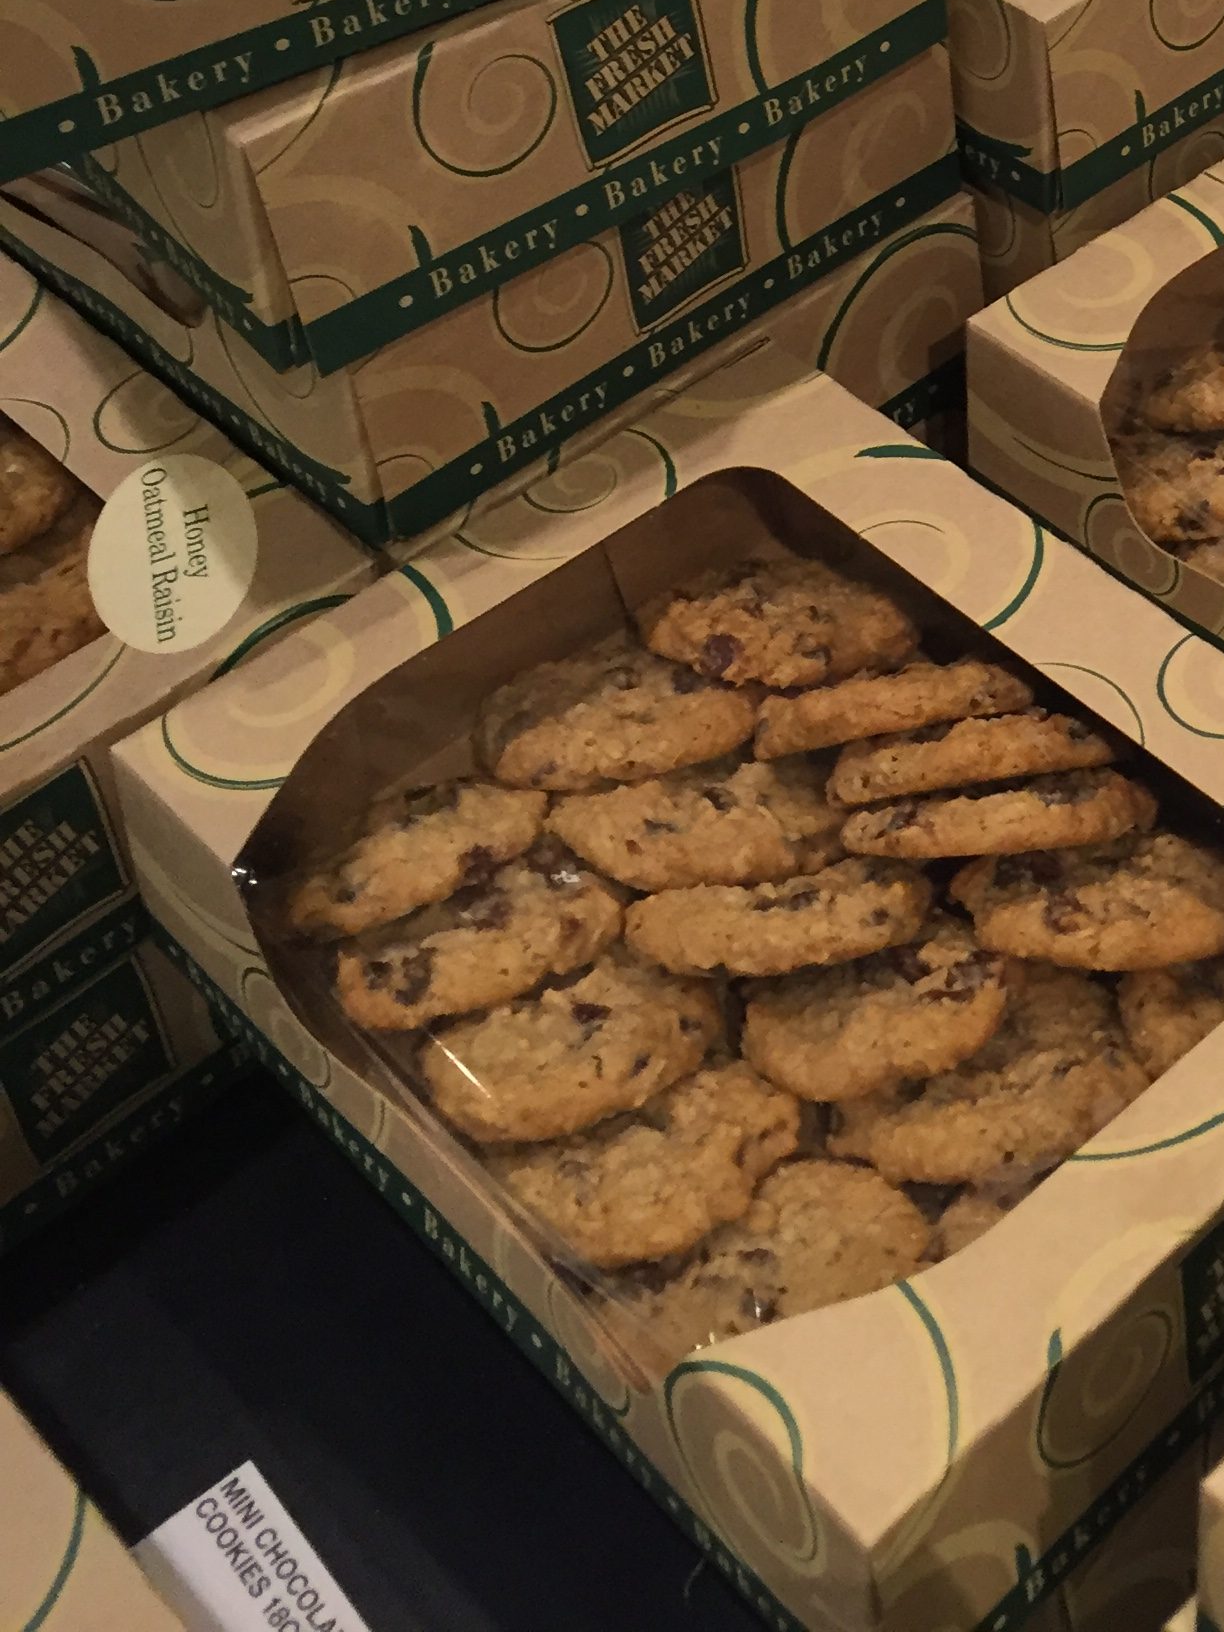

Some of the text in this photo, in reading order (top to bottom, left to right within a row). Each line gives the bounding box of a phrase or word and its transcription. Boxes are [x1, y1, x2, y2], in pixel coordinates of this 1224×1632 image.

[585, 15, 678, 102] FRESH
[587, 4, 649, 61] THE
[95, 51, 254, 127] Bakery
[587, 31, 695, 136] MARKET
[428, 53, 869, 298] Bakery Bakery Bakery
[641, 189, 698, 239] THE
[636, 205, 736, 306] MARKET
[637, 193, 721, 275] FRESH
[496, 209, 886, 463] Bakery Bakery Bakery
[141, 468, 183, 644] Oatmeal Raisin
[183, 504, 210, 578] Honey
[0, 818, 43, 867] HE
[0, 820, 76, 908] RESH
[1, 917, 138, 1021] Bakery
[424, 1208, 518, 1331] Bakery
[195, 1497, 271, 1599] COOKIES
[220, 1476, 344, 1632] MINI CHOCOLA
